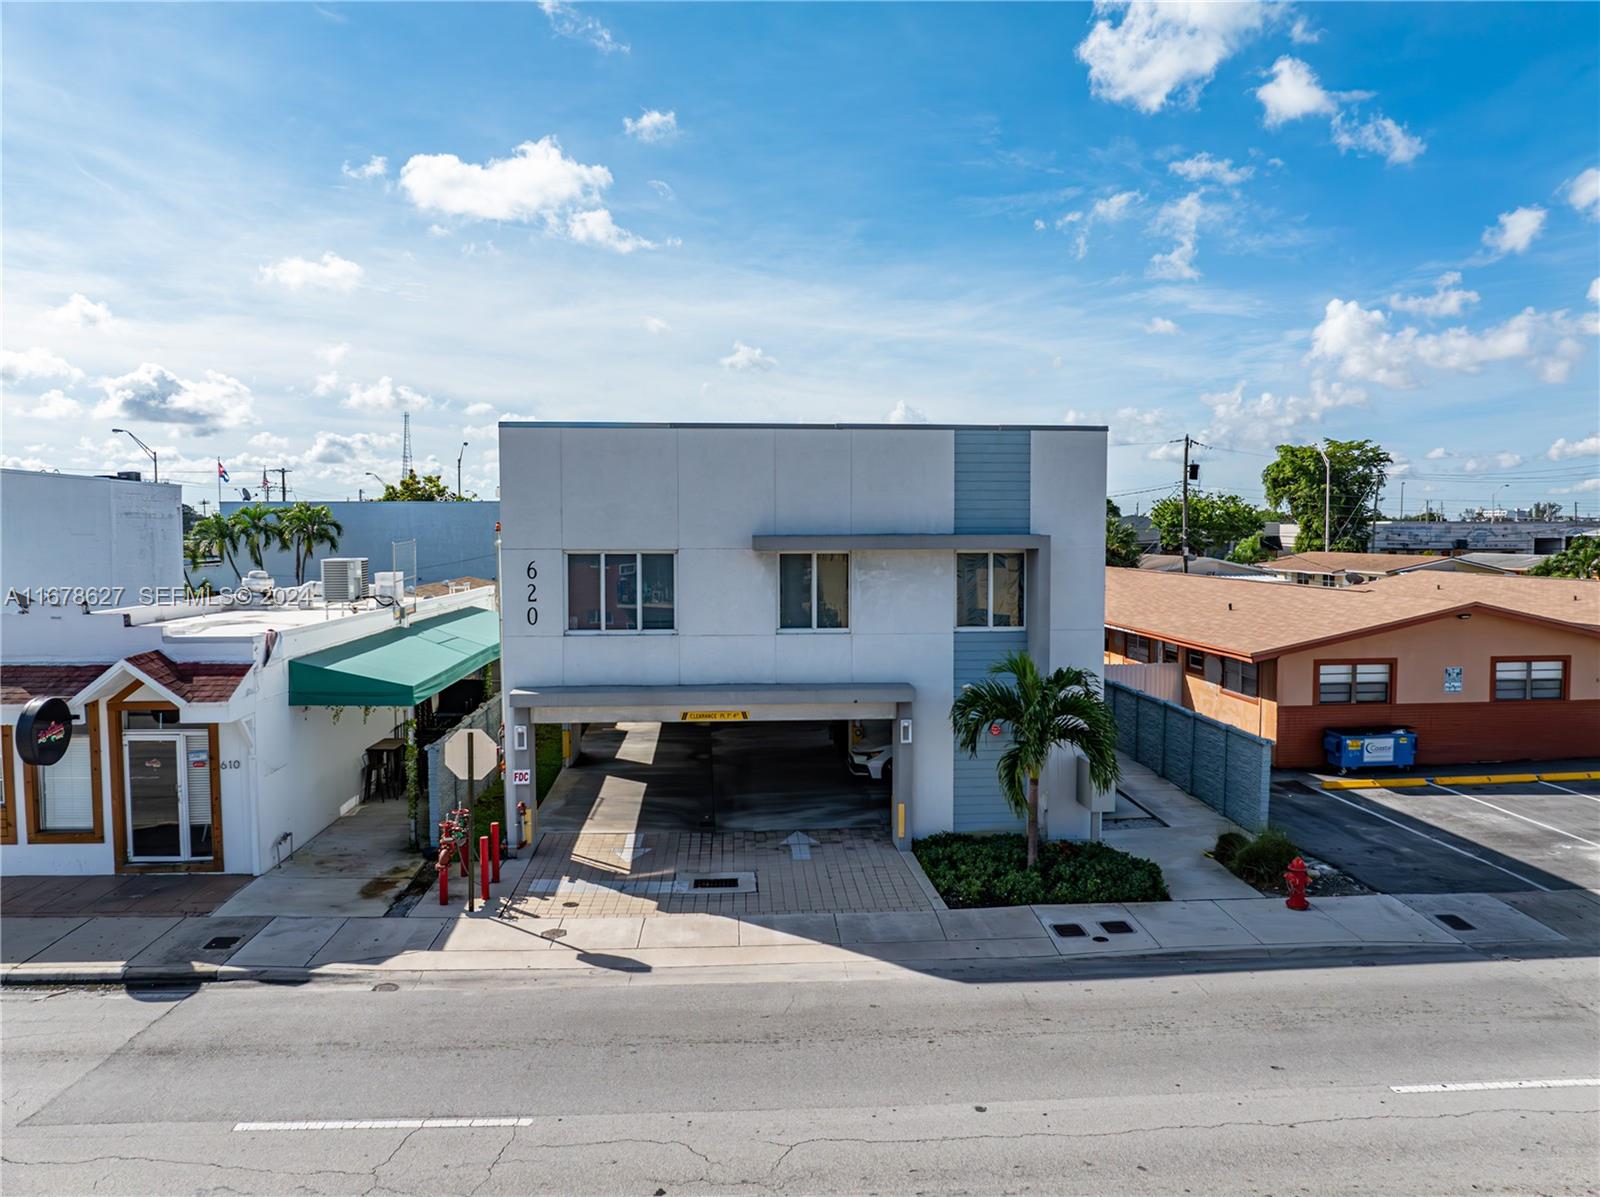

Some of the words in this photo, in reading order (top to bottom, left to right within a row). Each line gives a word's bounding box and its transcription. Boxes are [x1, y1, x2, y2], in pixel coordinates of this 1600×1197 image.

[526, 560, 538, 625] 620
[689, 712, 718, 720] CLEARANCE
[220, 760, 240, 770] 610
[513, 772, 529, 782] FDC
